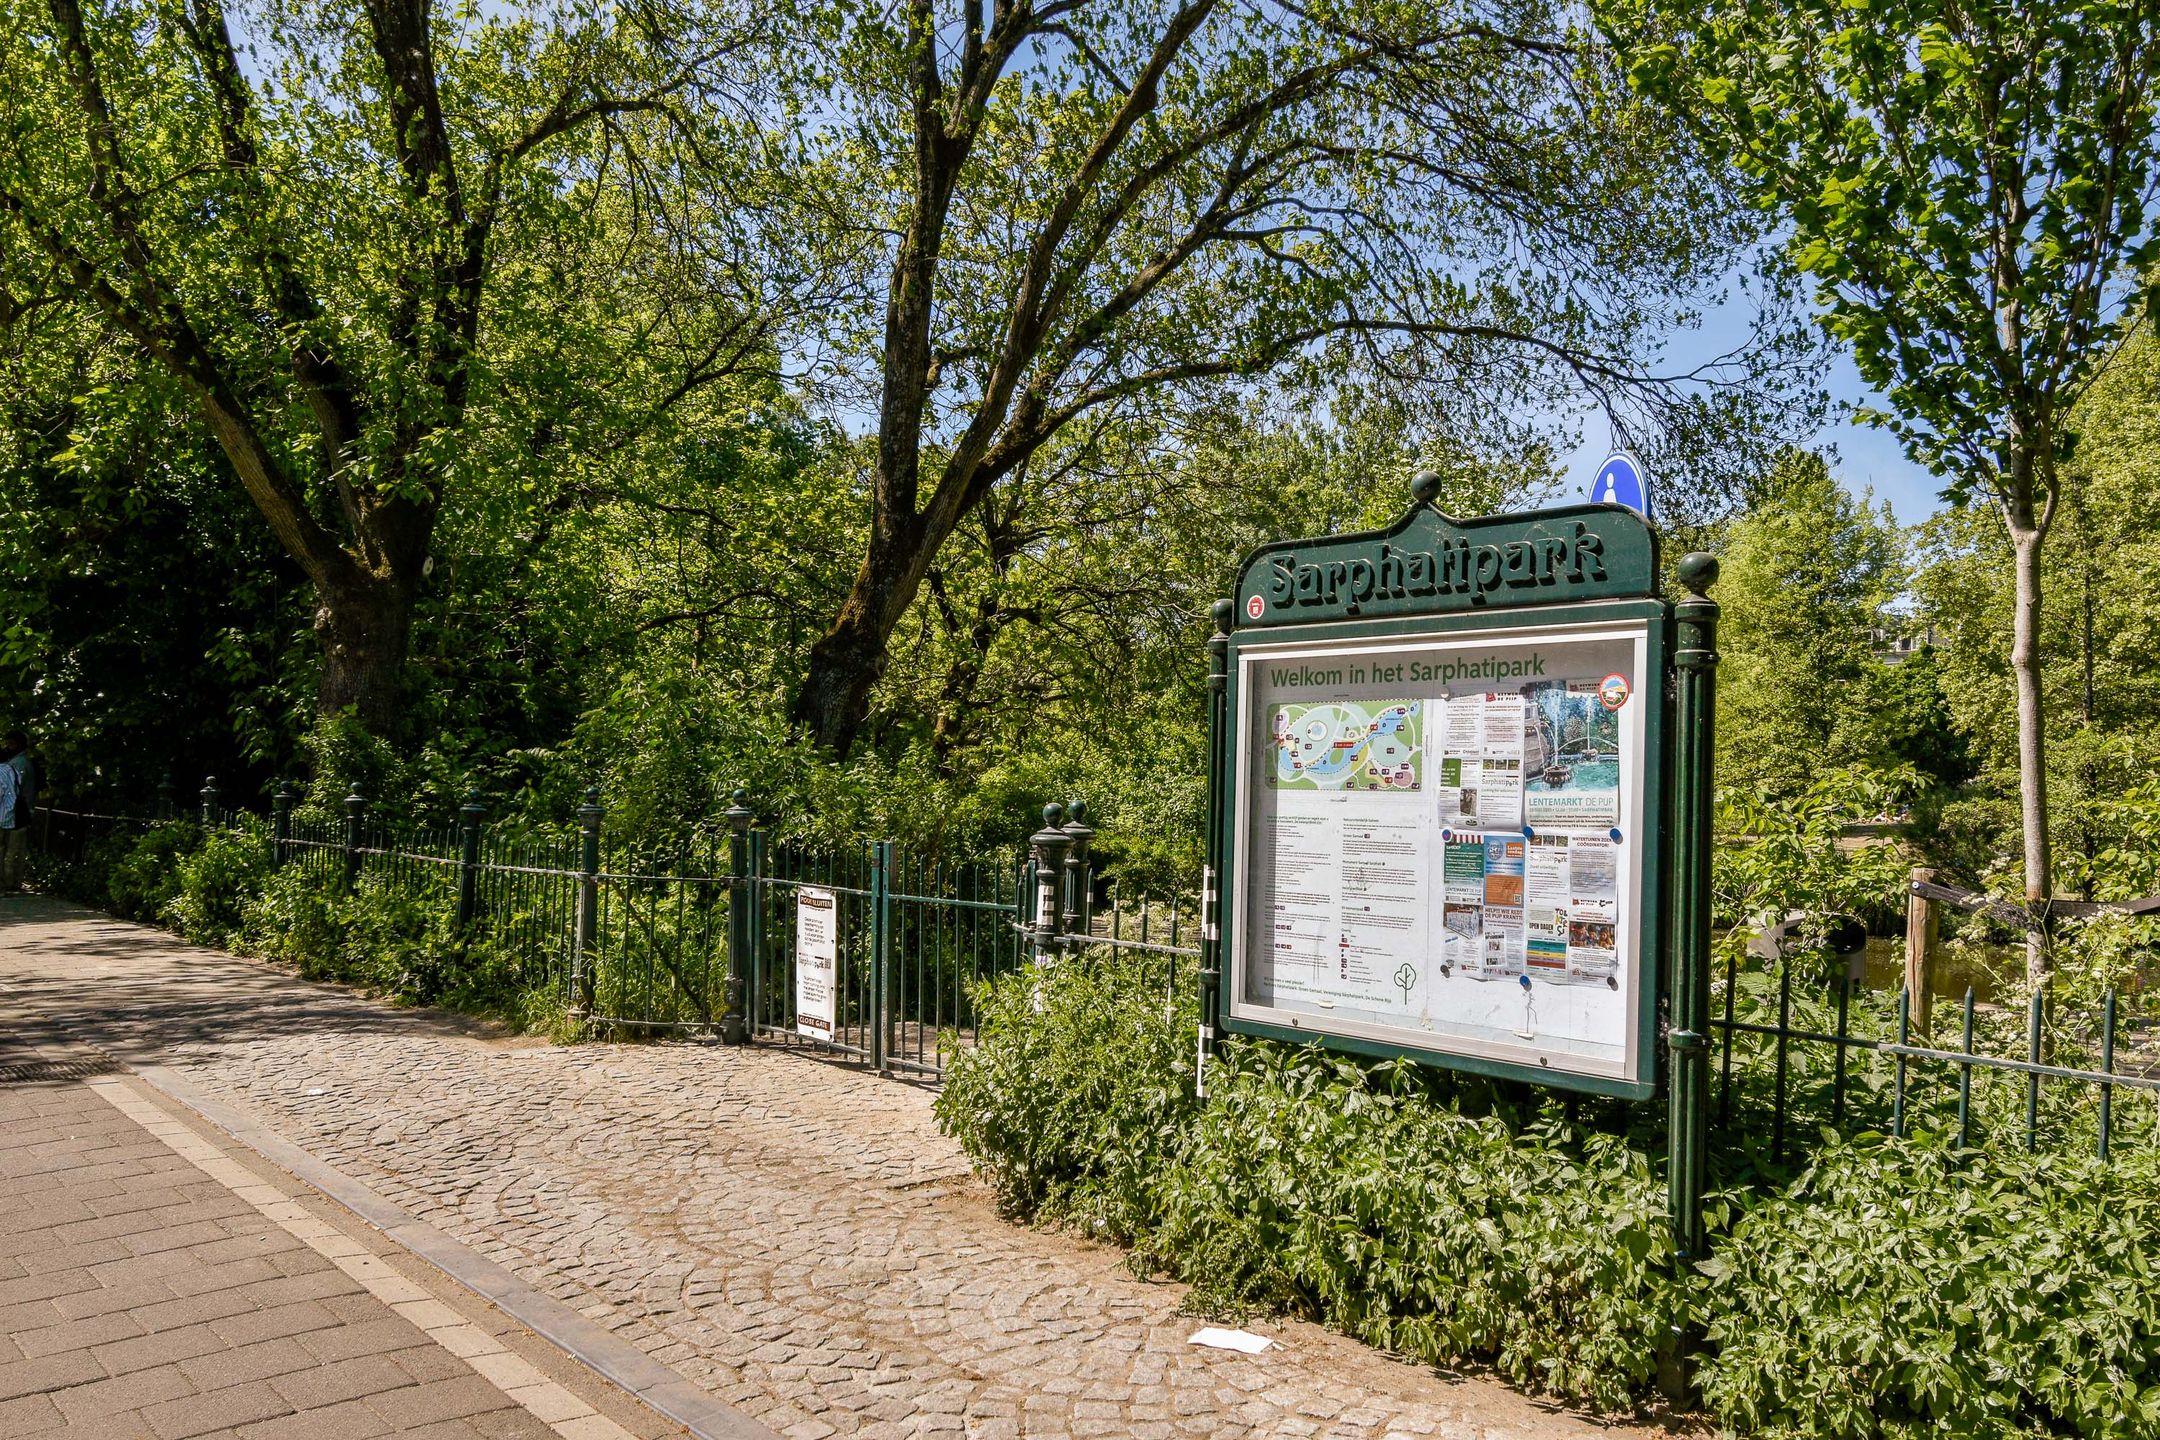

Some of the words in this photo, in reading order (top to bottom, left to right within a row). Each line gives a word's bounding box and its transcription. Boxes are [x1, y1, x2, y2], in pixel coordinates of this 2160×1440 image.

[1269, 520, 1609, 615] Sarphatipark
[1270, 663, 1342, 688] Welkom
[1349, 664, 1364, 685] in
[1372, 662, 1404, 684] het
[1411, 653, 1546, 686] Sarphatipark
[1529, 798, 1583, 806] LENTEMARKT
[1586, 798, 1597, 806] DE
[812, 899, 832, 907] SLUITEN
[800, 1016, 814, 1026] CLOSE
